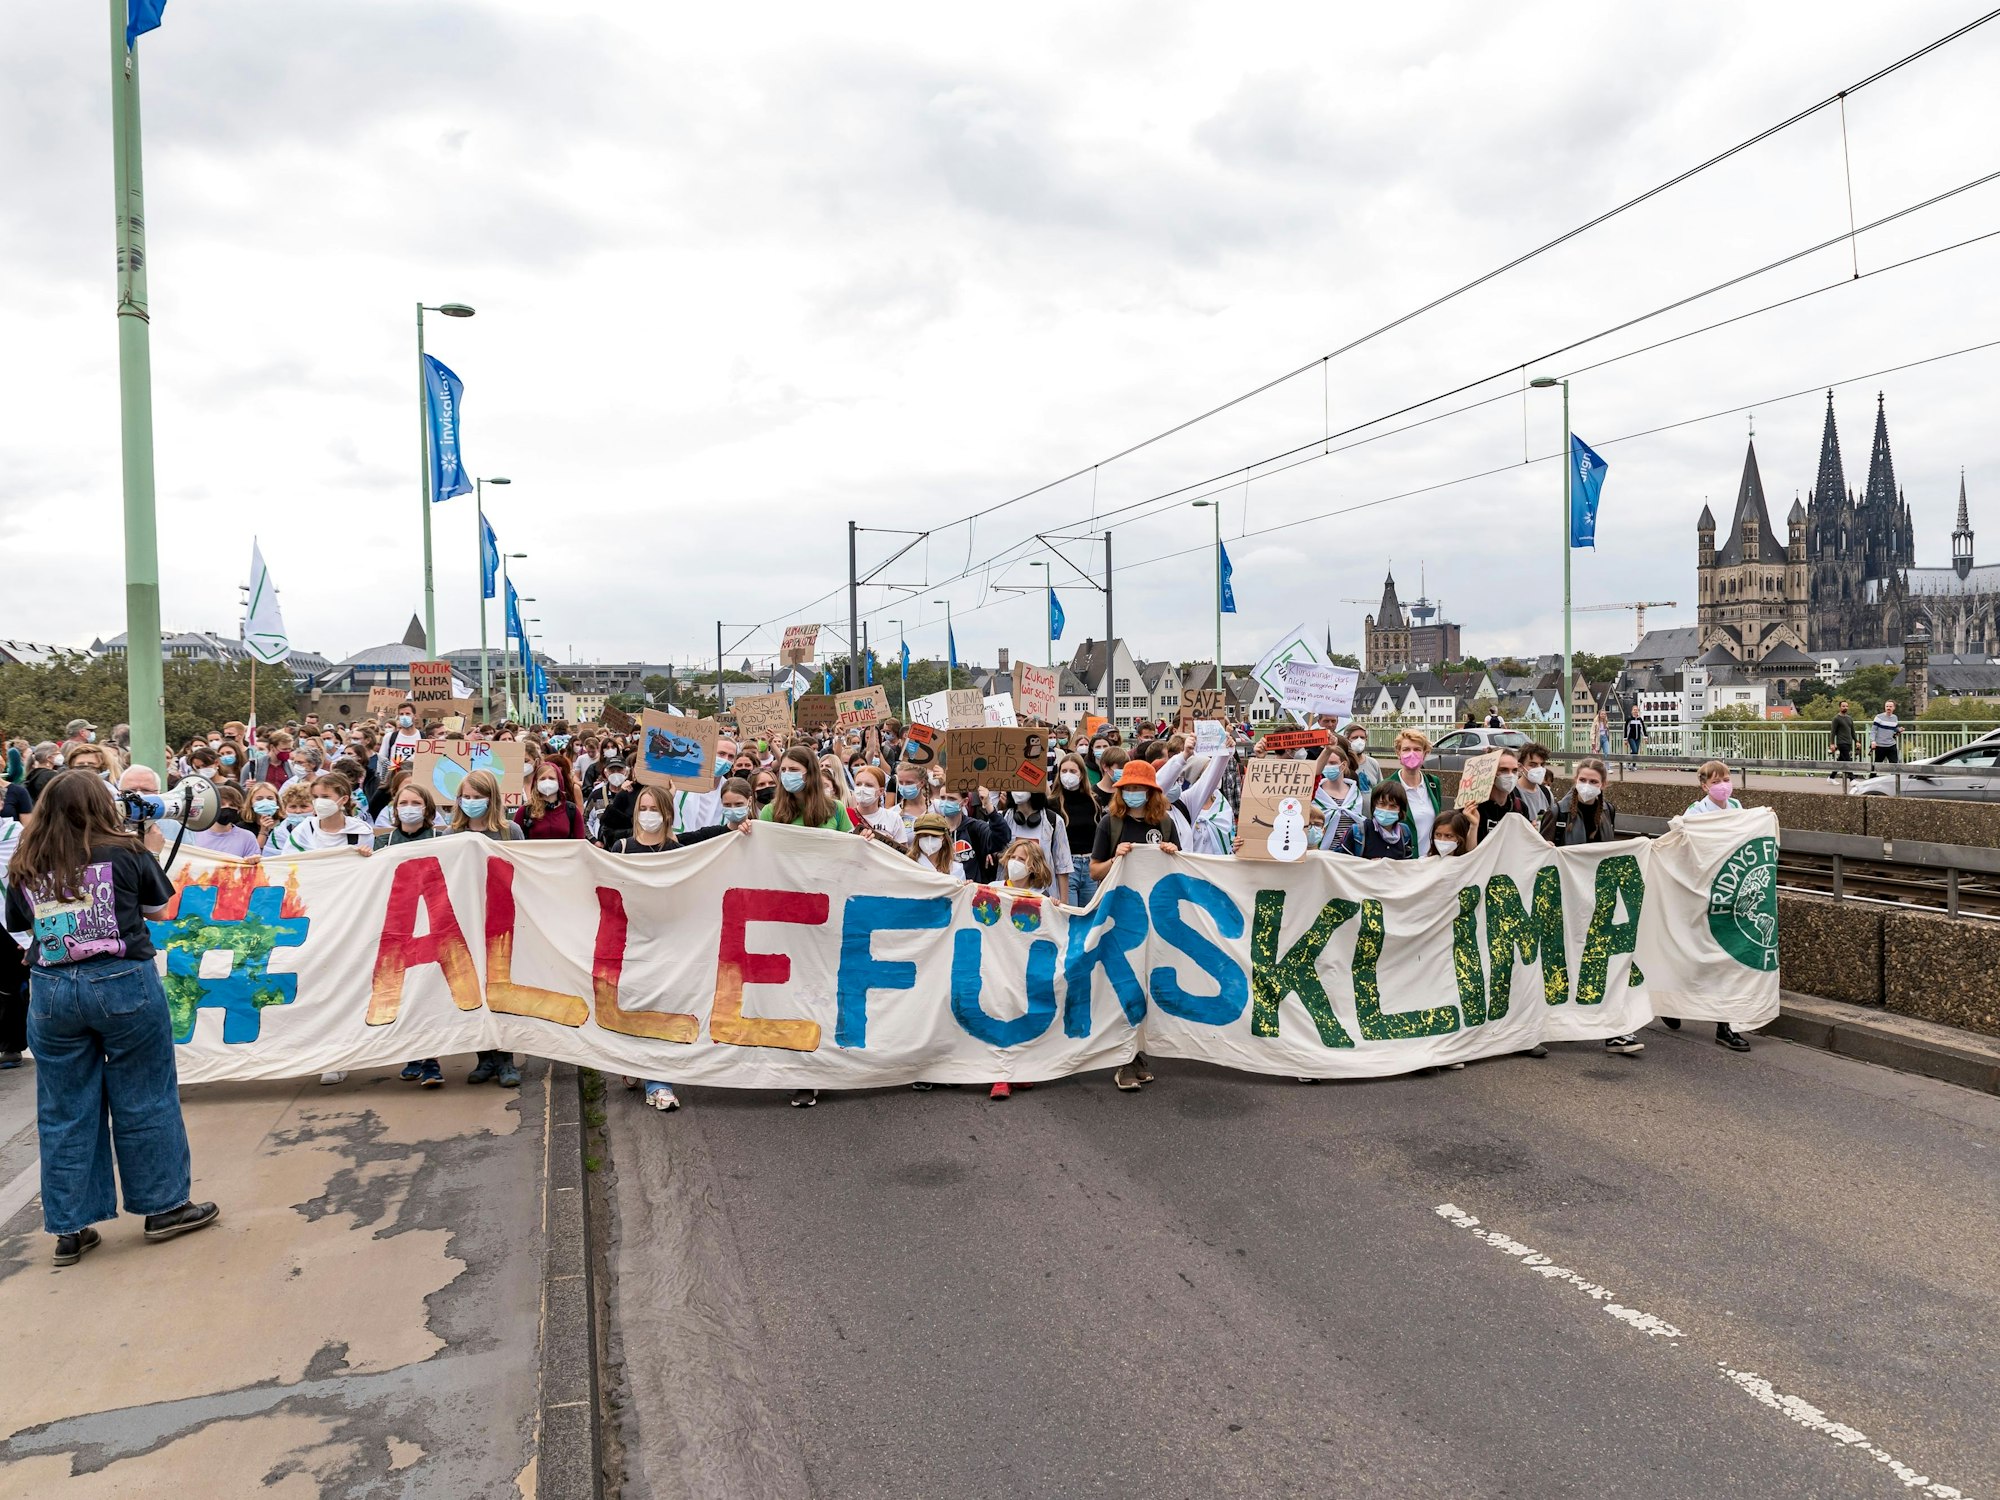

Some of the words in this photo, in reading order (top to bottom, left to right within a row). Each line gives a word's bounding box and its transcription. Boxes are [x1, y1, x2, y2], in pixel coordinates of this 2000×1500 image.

[410, 663, 451, 674] POLITIK
[414, 676, 448, 687] KLIMA
[373, 688, 386, 696] WE
[413, 690, 453, 701] WANDEL
[1183, 689, 1222, 709] SAVE
[840, 709, 877, 724] FUTURE
[915, 711, 930, 723] MY
[1192, 709, 1213, 718] OUR
[416, 740, 447, 755] DIE
[456, 741, 490, 756] UHR
[951, 732, 985, 756] Make
[993, 731, 1016, 755] the
[962, 755, 1018, 772] WORLD
[1251, 763, 1299, 774] HILFE!!!
[947, 773, 980, 791] cool
[986, 777, 1025, 791] again
[1251, 772, 1311, 785] RETTET
[1710, 844, 1758, 915] FRIDAYS
